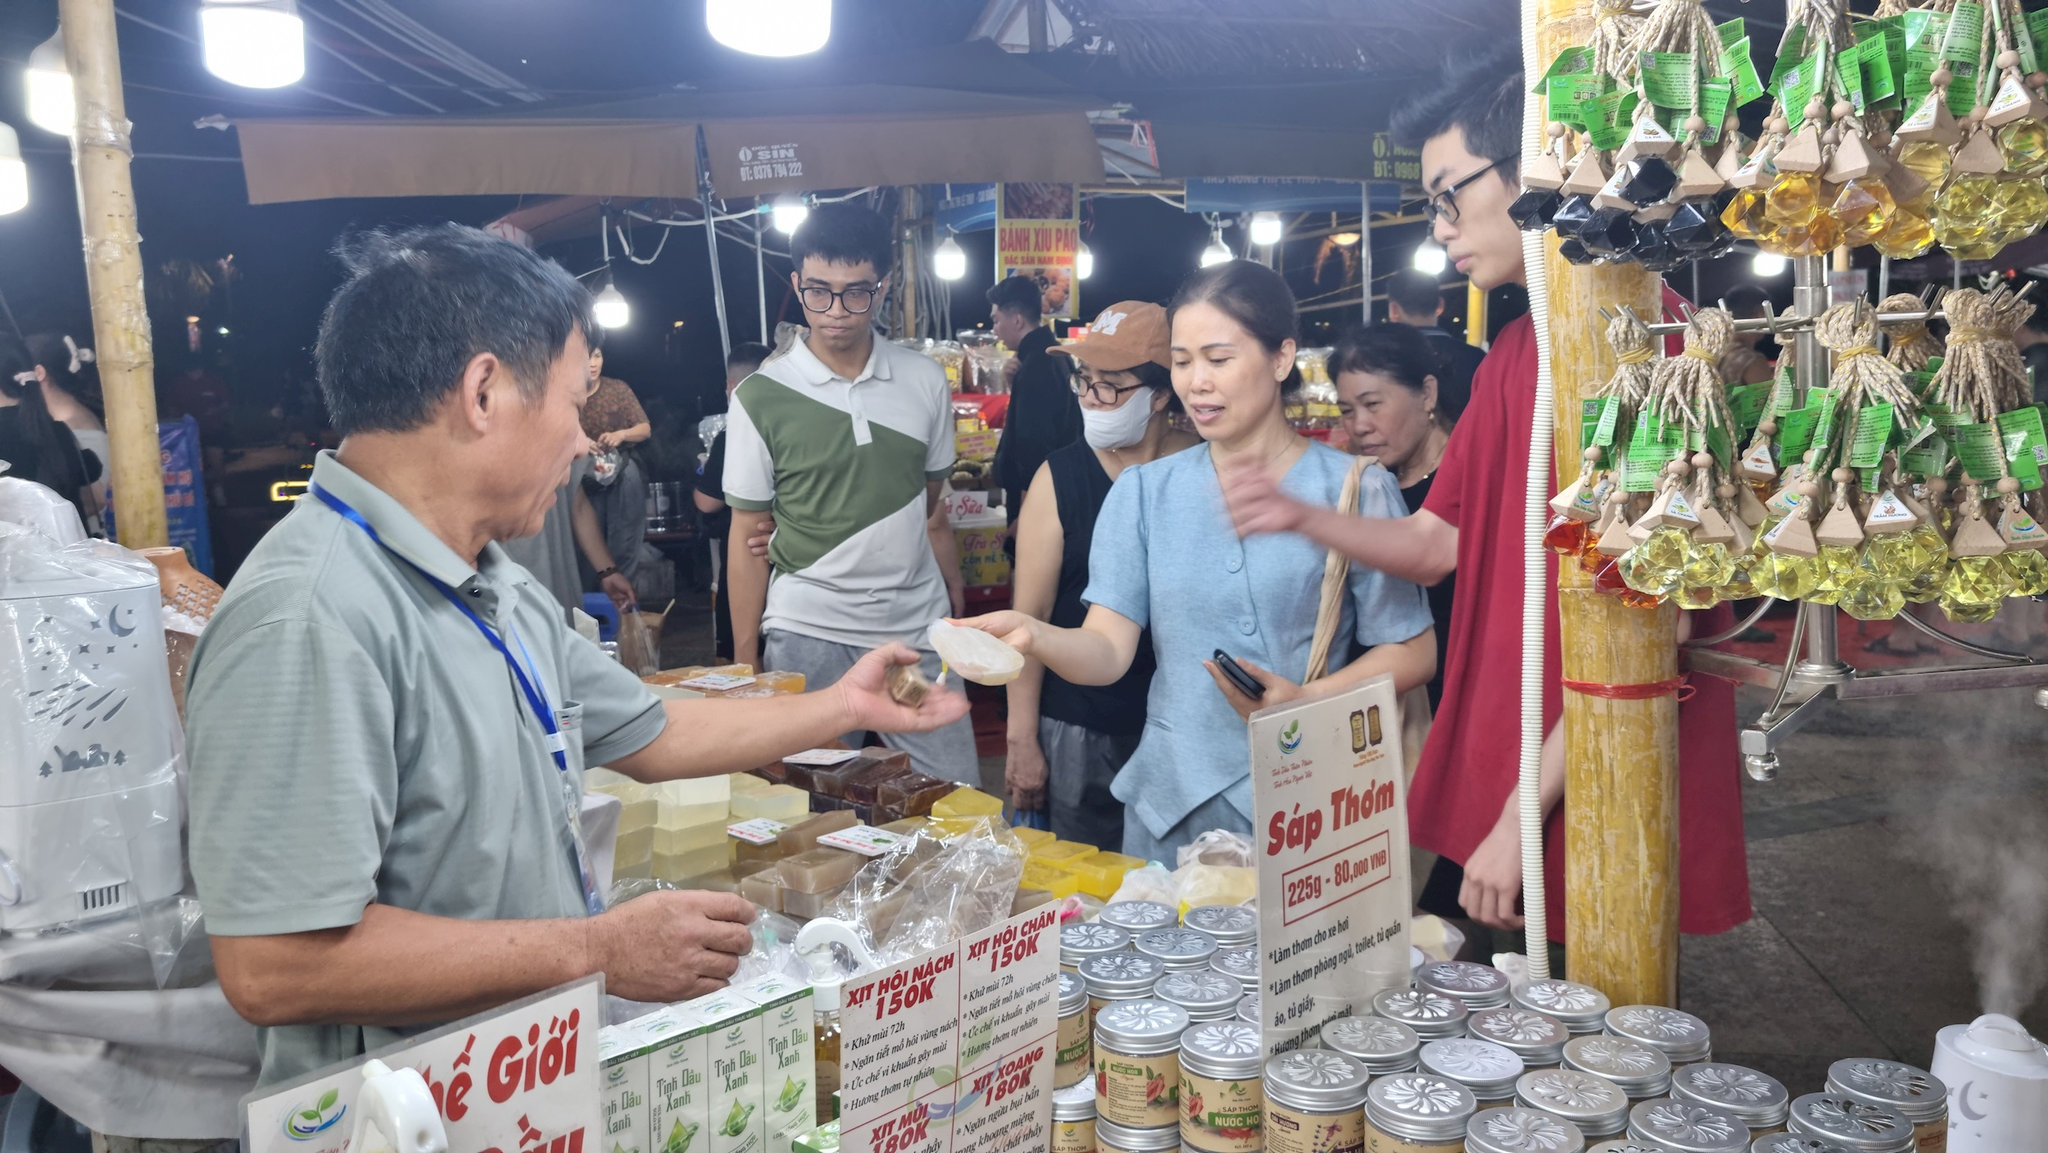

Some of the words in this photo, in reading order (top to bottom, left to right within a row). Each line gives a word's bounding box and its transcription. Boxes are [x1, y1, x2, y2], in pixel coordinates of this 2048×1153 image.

[757, 148, 795, 160] SIN
[1000, 222, 1031, 252] BÁNH
[1034, 222, 1052, 252] XÍU
[1055, 223, 1078, 252] PÁO
[1091, 310, 1128, 336] M
[1267, 802, 1323, 856] Sáp
[1330, 778, 1394, 832] Thơm
[1288, 874, 1322, 908] 225g
[967, 937, 991, 962] XỊT
[992, 924, 1018, 951] HÔI
[1020, 909, 1056, 938] CHÂN
[990, 931, 1041, 974] 150K
[1273, 947, 1291, 965] Làm
[1292, 936, 1313, 956] thơm
[1313, 929, 1327, 946] cho
[1327, 925, 1337, 939] xe
[1337, 915, 1350, 934] hơi
[845, 982, 876, 1009] XỊT
[877, 969, 909, 997] HÔI
[911, 951, 955, 984] NÁCH
[1274, 978, 1291, 996] Làm
[1292, 967, 1313, 985] thơm
[1313, 955, 1338, 980] phòng
[1355, 934, 1376, 955] toilet,
[1376, 927, 1385, 944] tủ
[875, 976, 937, 1021] 150K
[968, 986, 986, 1002] Khử
[986, 978, 1000, 994] mùi
[1001, 973, 1014, 988] 72h
[968, 1004, 988, 1021] Ngăn
[989, 995, 1001, 1012] tiết
[1013, 986, 1025, 1000] hôi
[1026, 980, 1042, 994] vùng
[991, 1030, 1010, 1046] thơm
[1019, 1016, 1039, 1033] nhiên
[993, 1015, 1001, 1027] vi
[1000, 1004, 1023, 1024] khuẩn
[1274, 1010, 1287, 1027] áo,
[1287, 1001, 1297, 1020] tủ
[850, 1055, 875, 1071] Ngăn
[876, 1043, 890, 1061] tiết
[891, 1037, 905, 1055] mồ
[905, 1033, 919, 1049] hôi
[920, 1027, 939, 1041] vùng
[939, 1017, 958, 1034] nách
[851, 1033, 873, 1051] Khử
[872, 1026, 889, 1042] mùi
[890, 1020, 906, 1036] 72h
[1274, 1034, 1300, 1056] Hương
[1300, 1023, 1320, 1042] thơm
[415, 1033, 477, 1123] hế
[486, 1007, 580, 1104] Giới
[777, 1049, 800, 1071] Xanh
[851, 1075, 864, 1091] Ức
[865, 1066, 882, 1085] chế
[882, 1065, 890, 1077] vi
[890, 1052, 917, 1074] khuẩn
[917, 1048, 932, 1064] gây
[932, 1039, 948, 1055] mùi
[970, 1070, 995, 1095] XỊT
[994, 1046, 1044, 1083] XOANG
[724, 1071, 748, 1093] Xanh
[850, 1091, 879, 1111] Hương
[880, 1082, 901, 1097] thơm
[902, 1075, 912, 1088] tự
[912, 1065, 935, 1083] nhiên
[984, 1064, 1034, 1107] 180K
[666, 1090, 691, 1112] Xanh
[962, 1116, 987, 1136] Ngăn
[1009, 1096, 1023, 1112] bụi
[977, 1124, 1010, 1148] khoang
[1214, 1115, 1244, 1127] NƯỚC
[1246, 1114, 1260, 1126] HO
